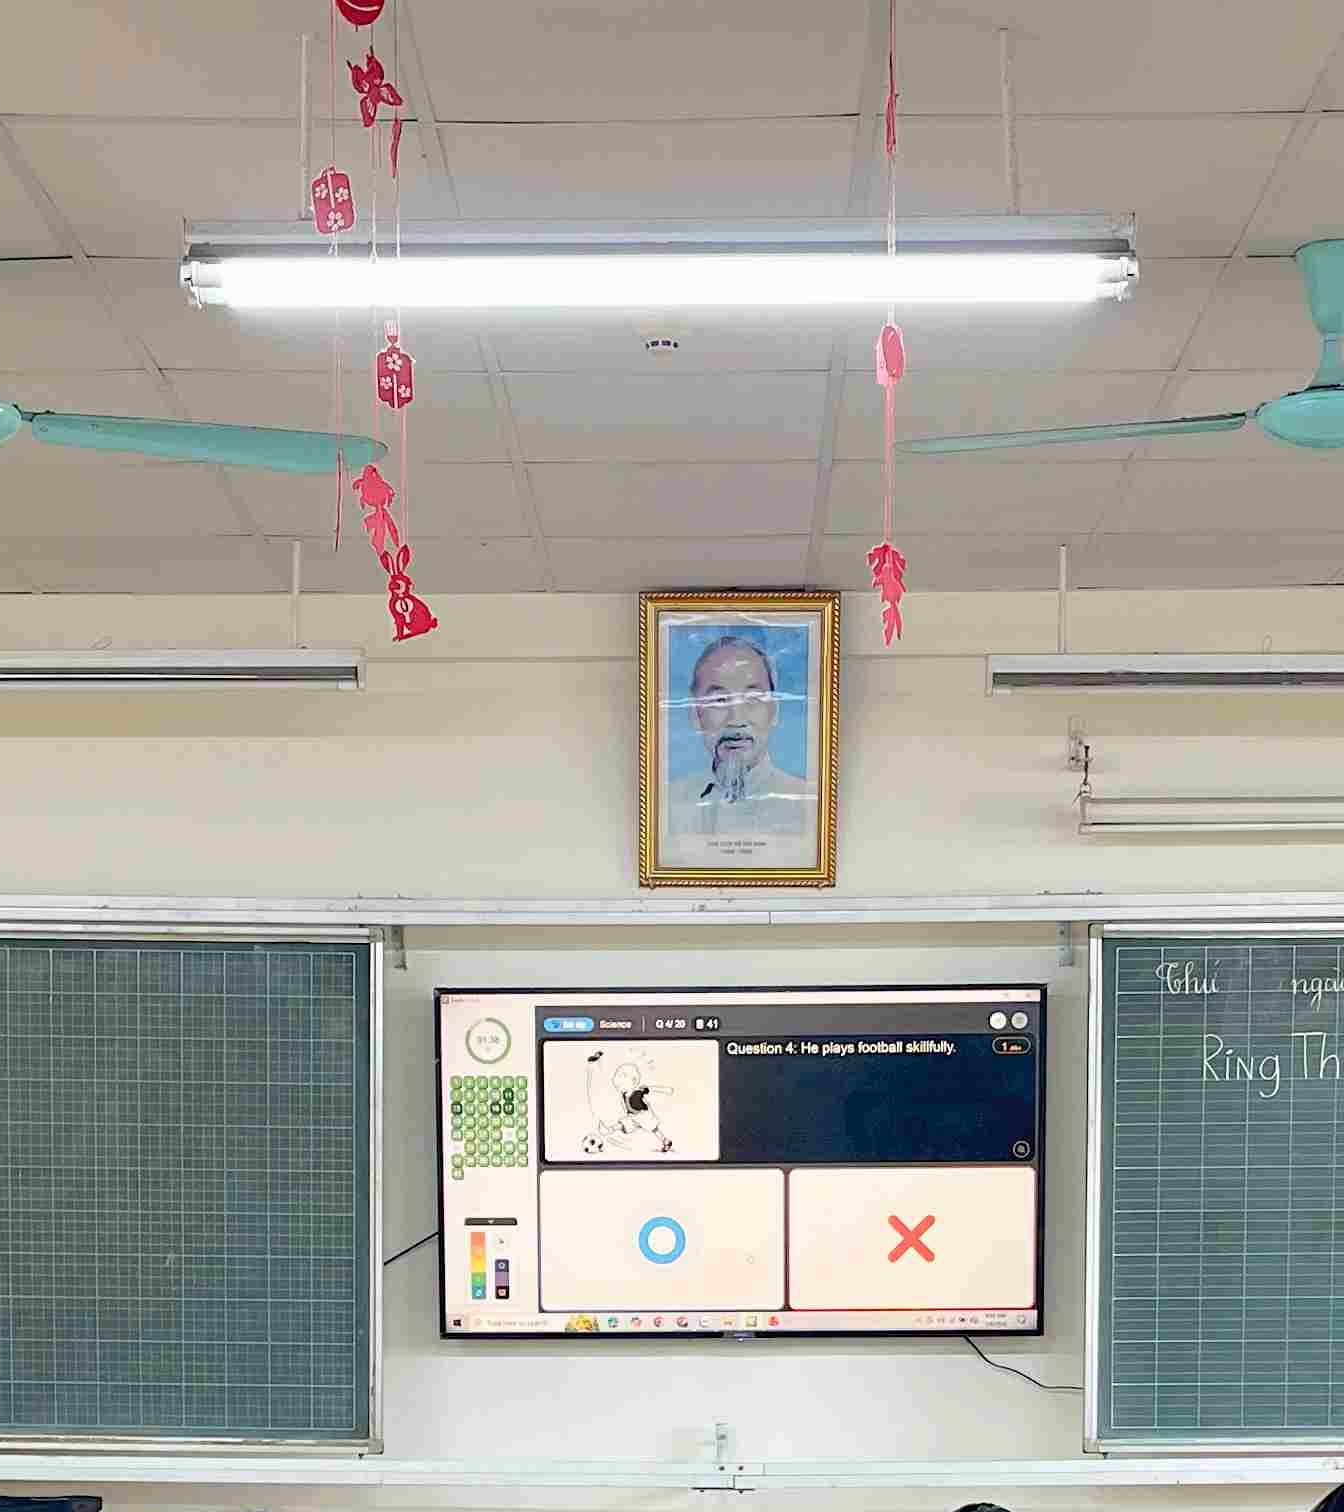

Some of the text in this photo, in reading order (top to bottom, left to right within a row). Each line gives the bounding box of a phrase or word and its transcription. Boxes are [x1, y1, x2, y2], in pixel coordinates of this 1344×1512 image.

[727, 1039, 957, 1057] Question 4: He plays football skillfully.
